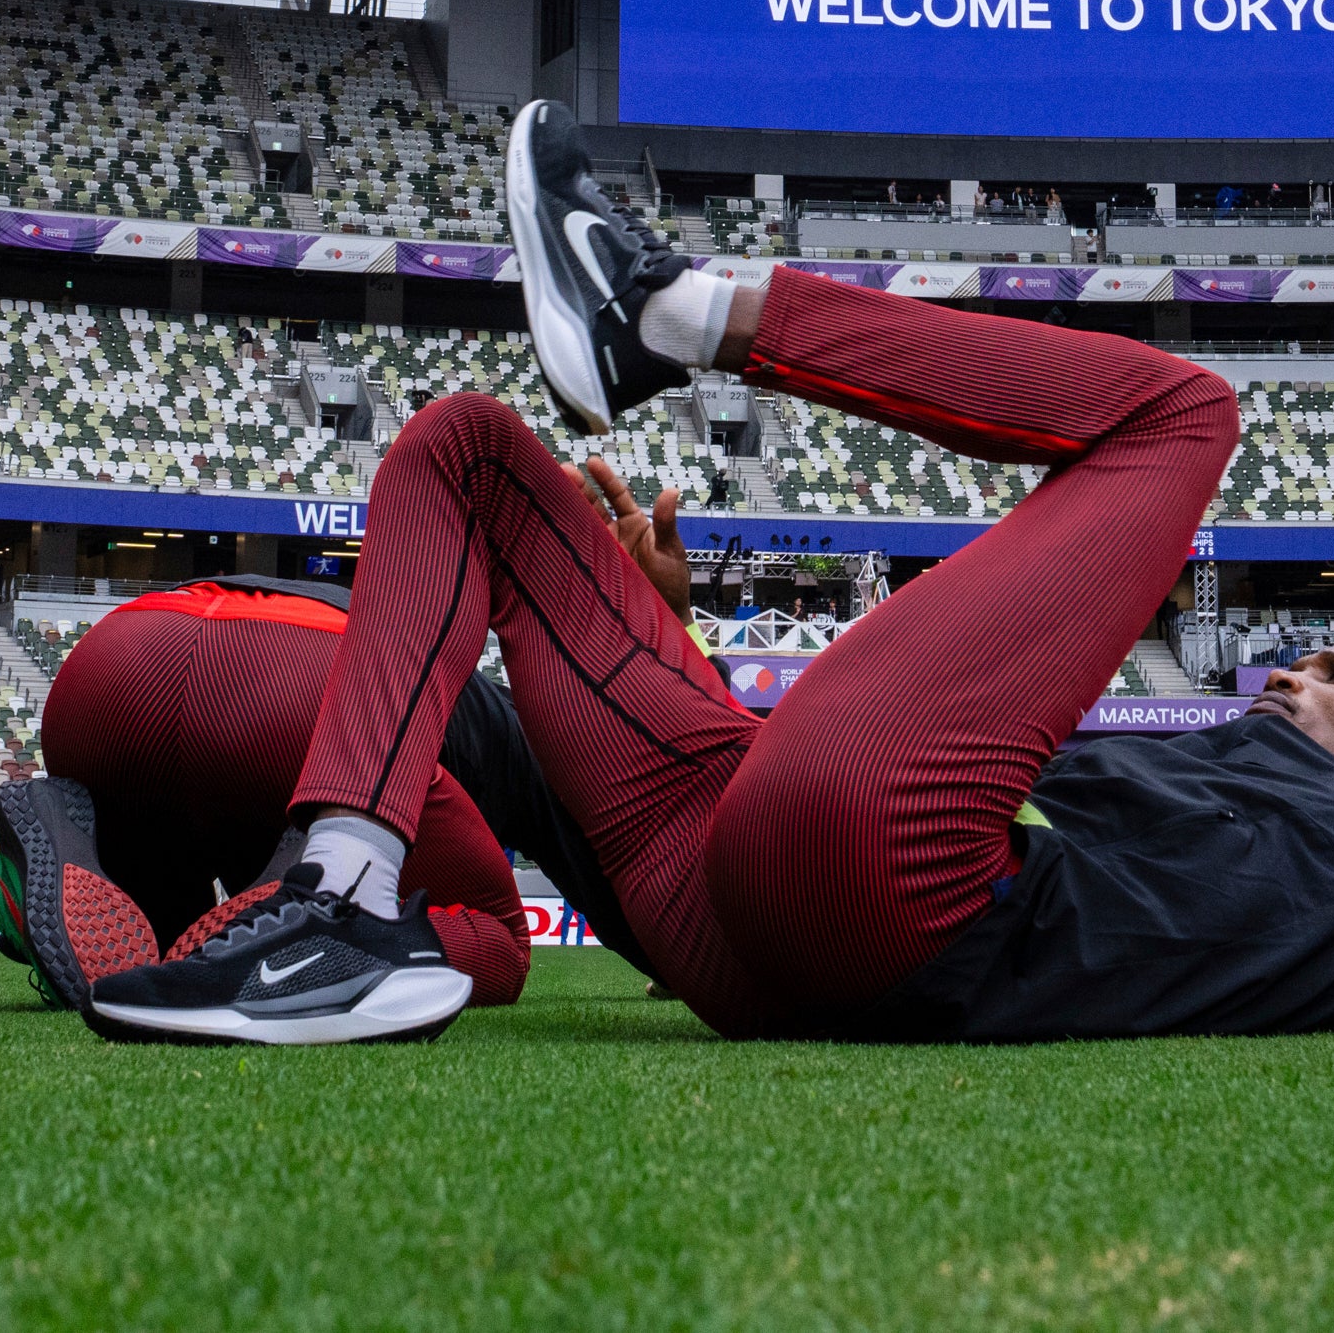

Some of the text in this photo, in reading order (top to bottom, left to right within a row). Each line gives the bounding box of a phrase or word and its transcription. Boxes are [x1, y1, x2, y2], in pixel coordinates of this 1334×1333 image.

[339, 373, 357, 383] 224
[730, 391, 748, 401] 223
[1099, 707, 1216, 725] MARATHON
